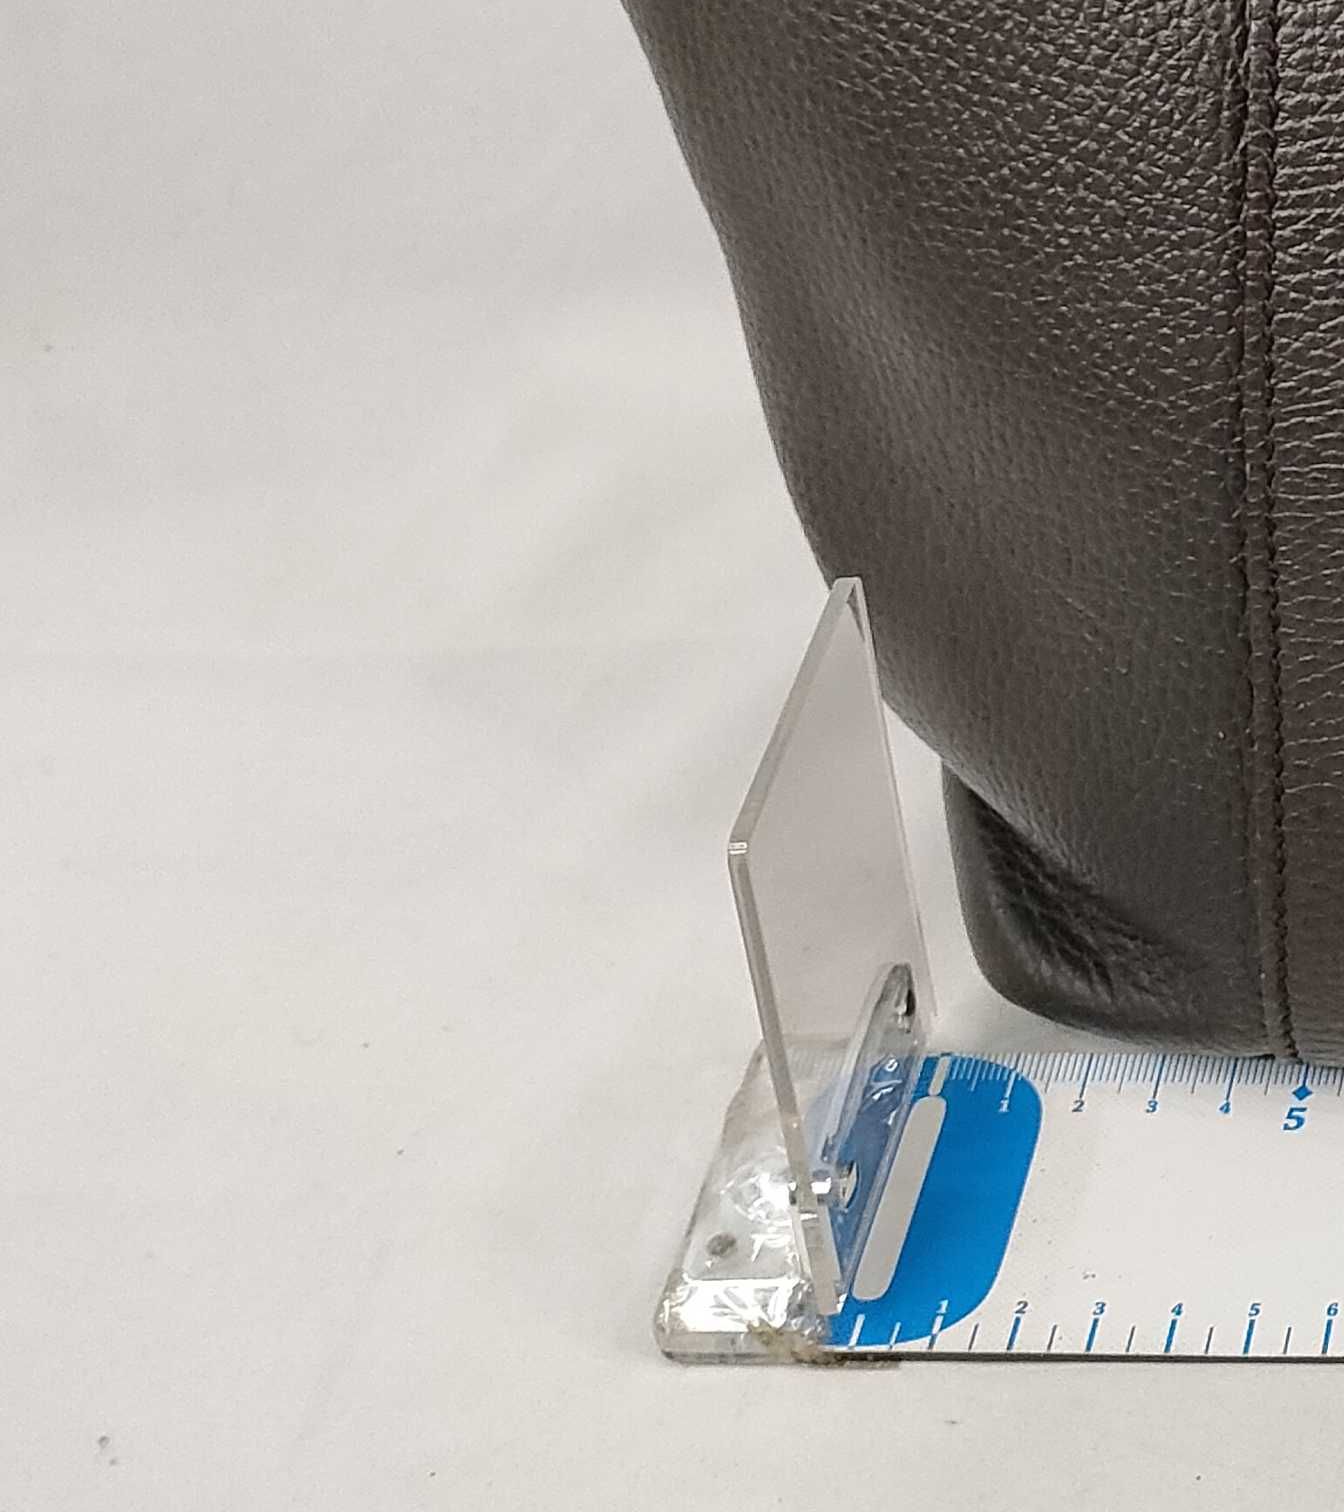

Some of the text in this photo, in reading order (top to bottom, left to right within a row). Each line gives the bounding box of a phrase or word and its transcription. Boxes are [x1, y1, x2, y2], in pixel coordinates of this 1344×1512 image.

[998, 1098, 1010, 1112] 1
[1072, 1100, 1085, 1113] 2
[1146, 1100, 1158, 1113] 3
[1219, 1102, 1231, 1114] 4
[1283, 1107, 1308, 1131] 5
[935, 1299, 949, 1314] 1
[1015, 1300, 1029, 1314] 2
[1092, 1302, 1106, 1316] 3
[1171, 1303, 1184, 1316] 4
[1247, 1303, 1262, 1316] 5
[1326, 1303, 1339, 1316] 6
